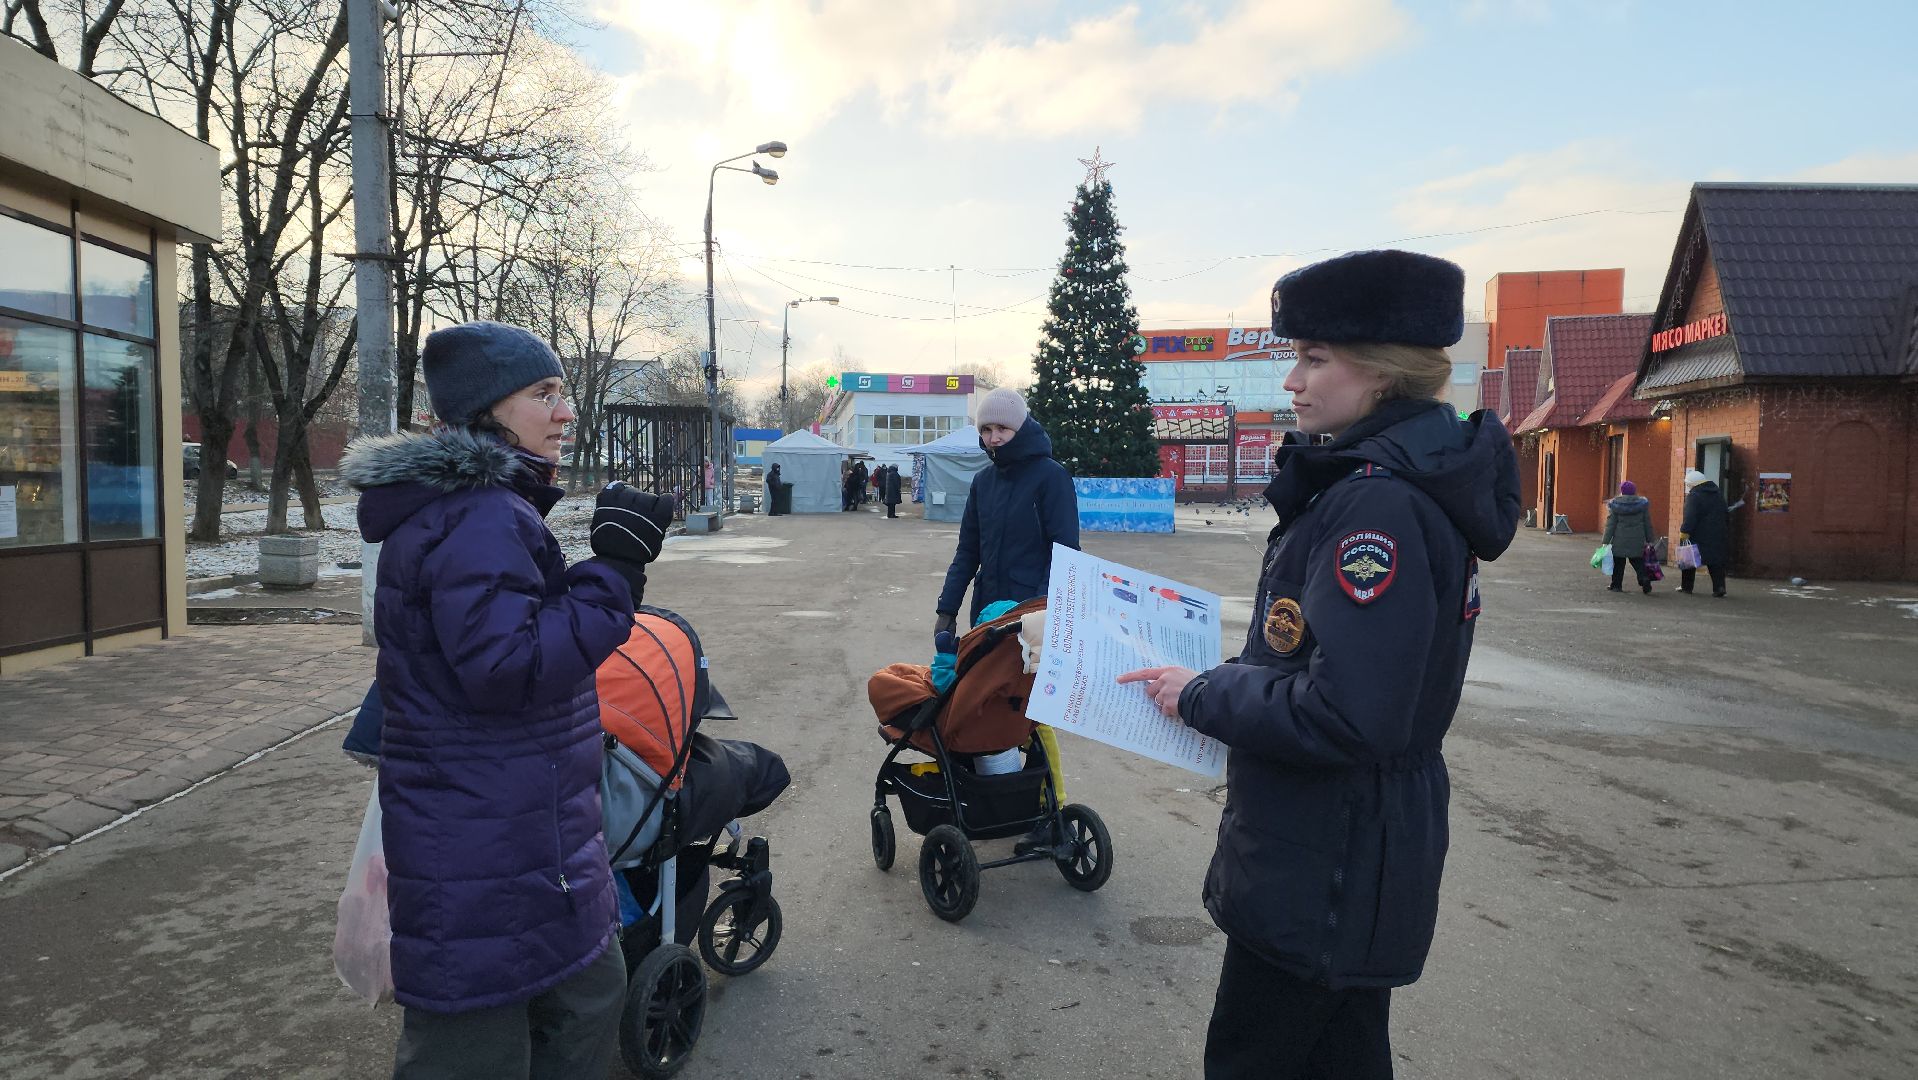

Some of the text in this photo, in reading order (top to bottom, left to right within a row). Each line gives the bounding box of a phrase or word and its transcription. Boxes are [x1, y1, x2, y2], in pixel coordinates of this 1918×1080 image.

[1652, 312, 1727, 353] МЯСО МАРКЕТ
[1151, 336, 1214, 353] FIX price
[1341, 533, 1393, 549] ПОЛИЦИЯ
[1343, 545, 1389, 562] РОССИЯ
[1354, 587, 1375, 600] МВД
[1063, 618, 1073, 653] БОЛЬШАЯ
